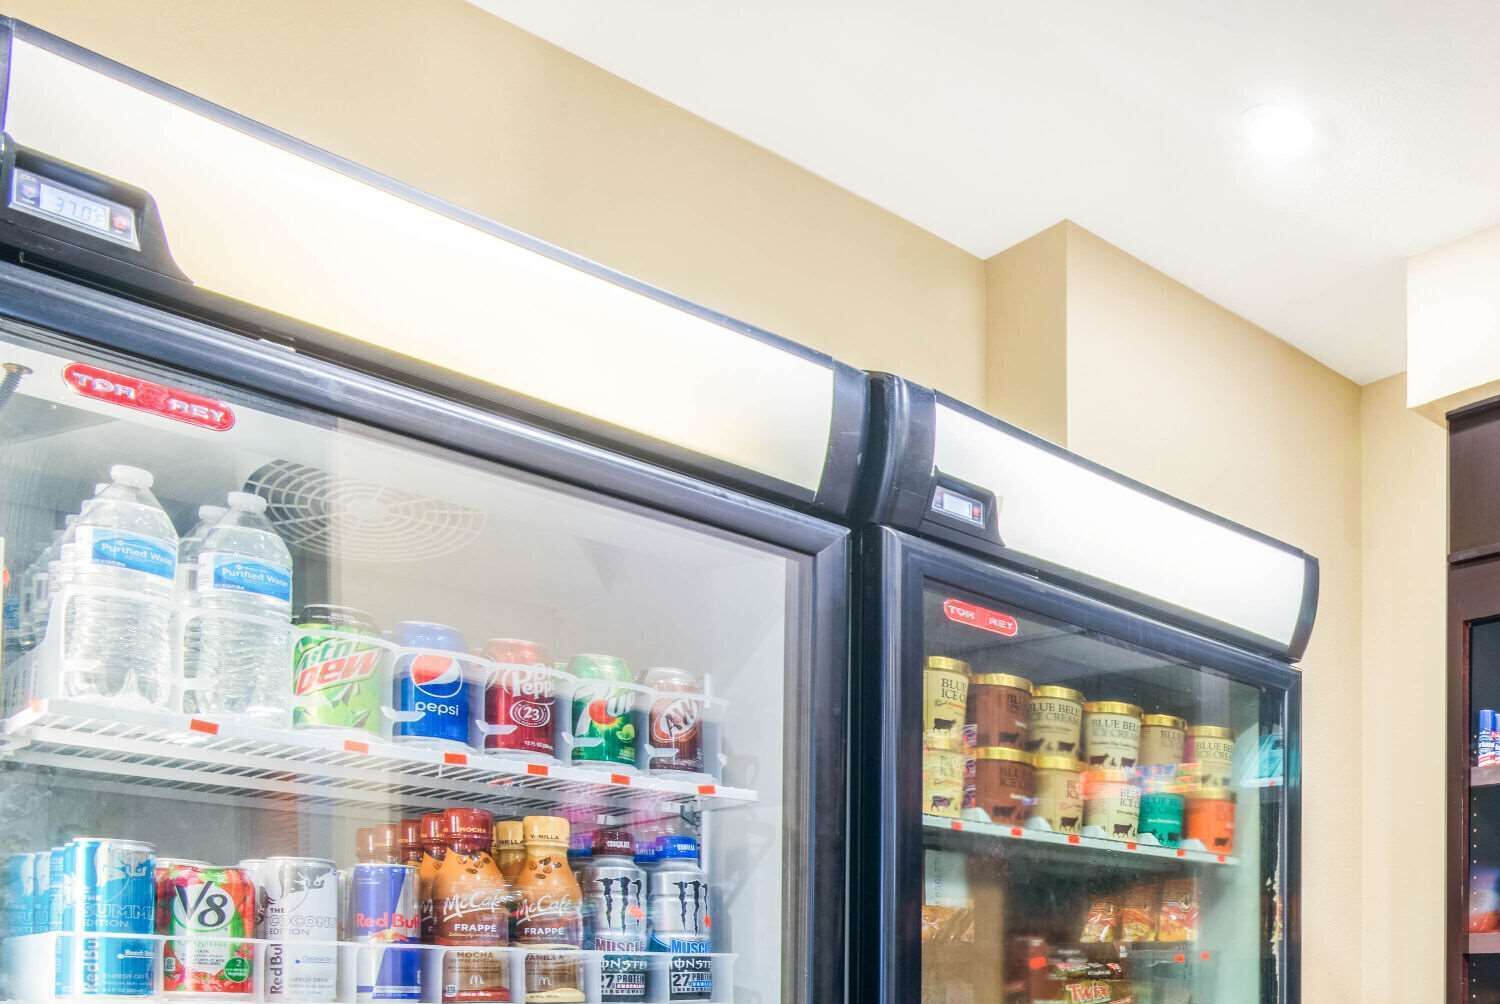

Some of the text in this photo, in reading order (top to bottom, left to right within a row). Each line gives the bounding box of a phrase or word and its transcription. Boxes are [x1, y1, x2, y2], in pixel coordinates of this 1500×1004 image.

[167, 397, 225, 424] REY
[415, 701, 460, 718] pepsi
[522, 706, 541, 720] 23
[175, 880, 228, 928] V8
[356, 912, 388, 928] Red
